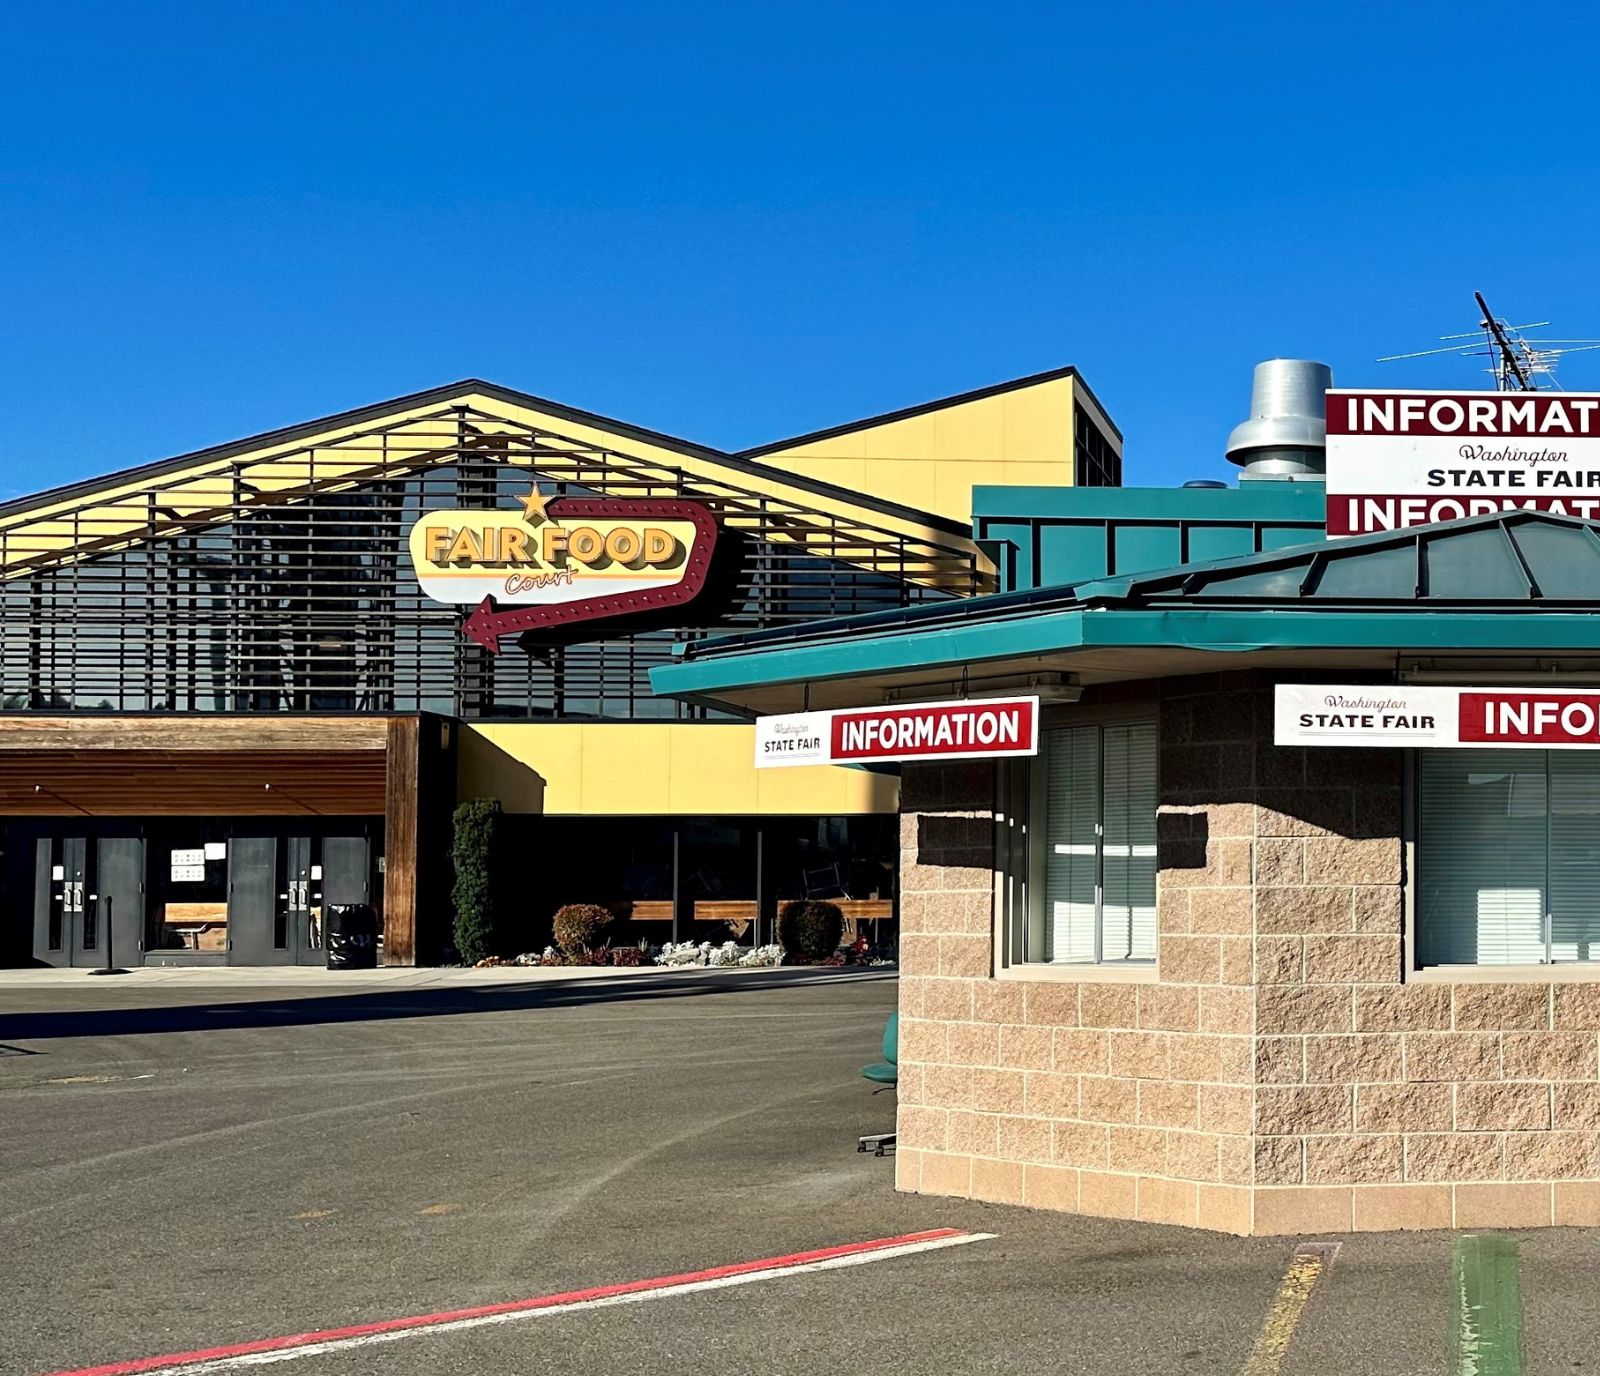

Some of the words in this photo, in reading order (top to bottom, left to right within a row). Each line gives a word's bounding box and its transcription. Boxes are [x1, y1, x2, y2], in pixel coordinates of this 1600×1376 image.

[1458, 444, 1570, 468] Washington
[1426, 468, 1526, 488] STATE
[424, 525, 534, 564] FAIR
[542, 526, 682, 565] FOOD
[504, 564, 578, 596] Court
[1324, 695, 1407, 712] Washington
[842, 711, 1019, 751] INFORMATION
[1299, 713, 1374, 728] STATE
[1382, 714, 1435, 729] FAIR
[764, 740, 794, 753] STATE
[797, 737, 821, 750] FAIR
